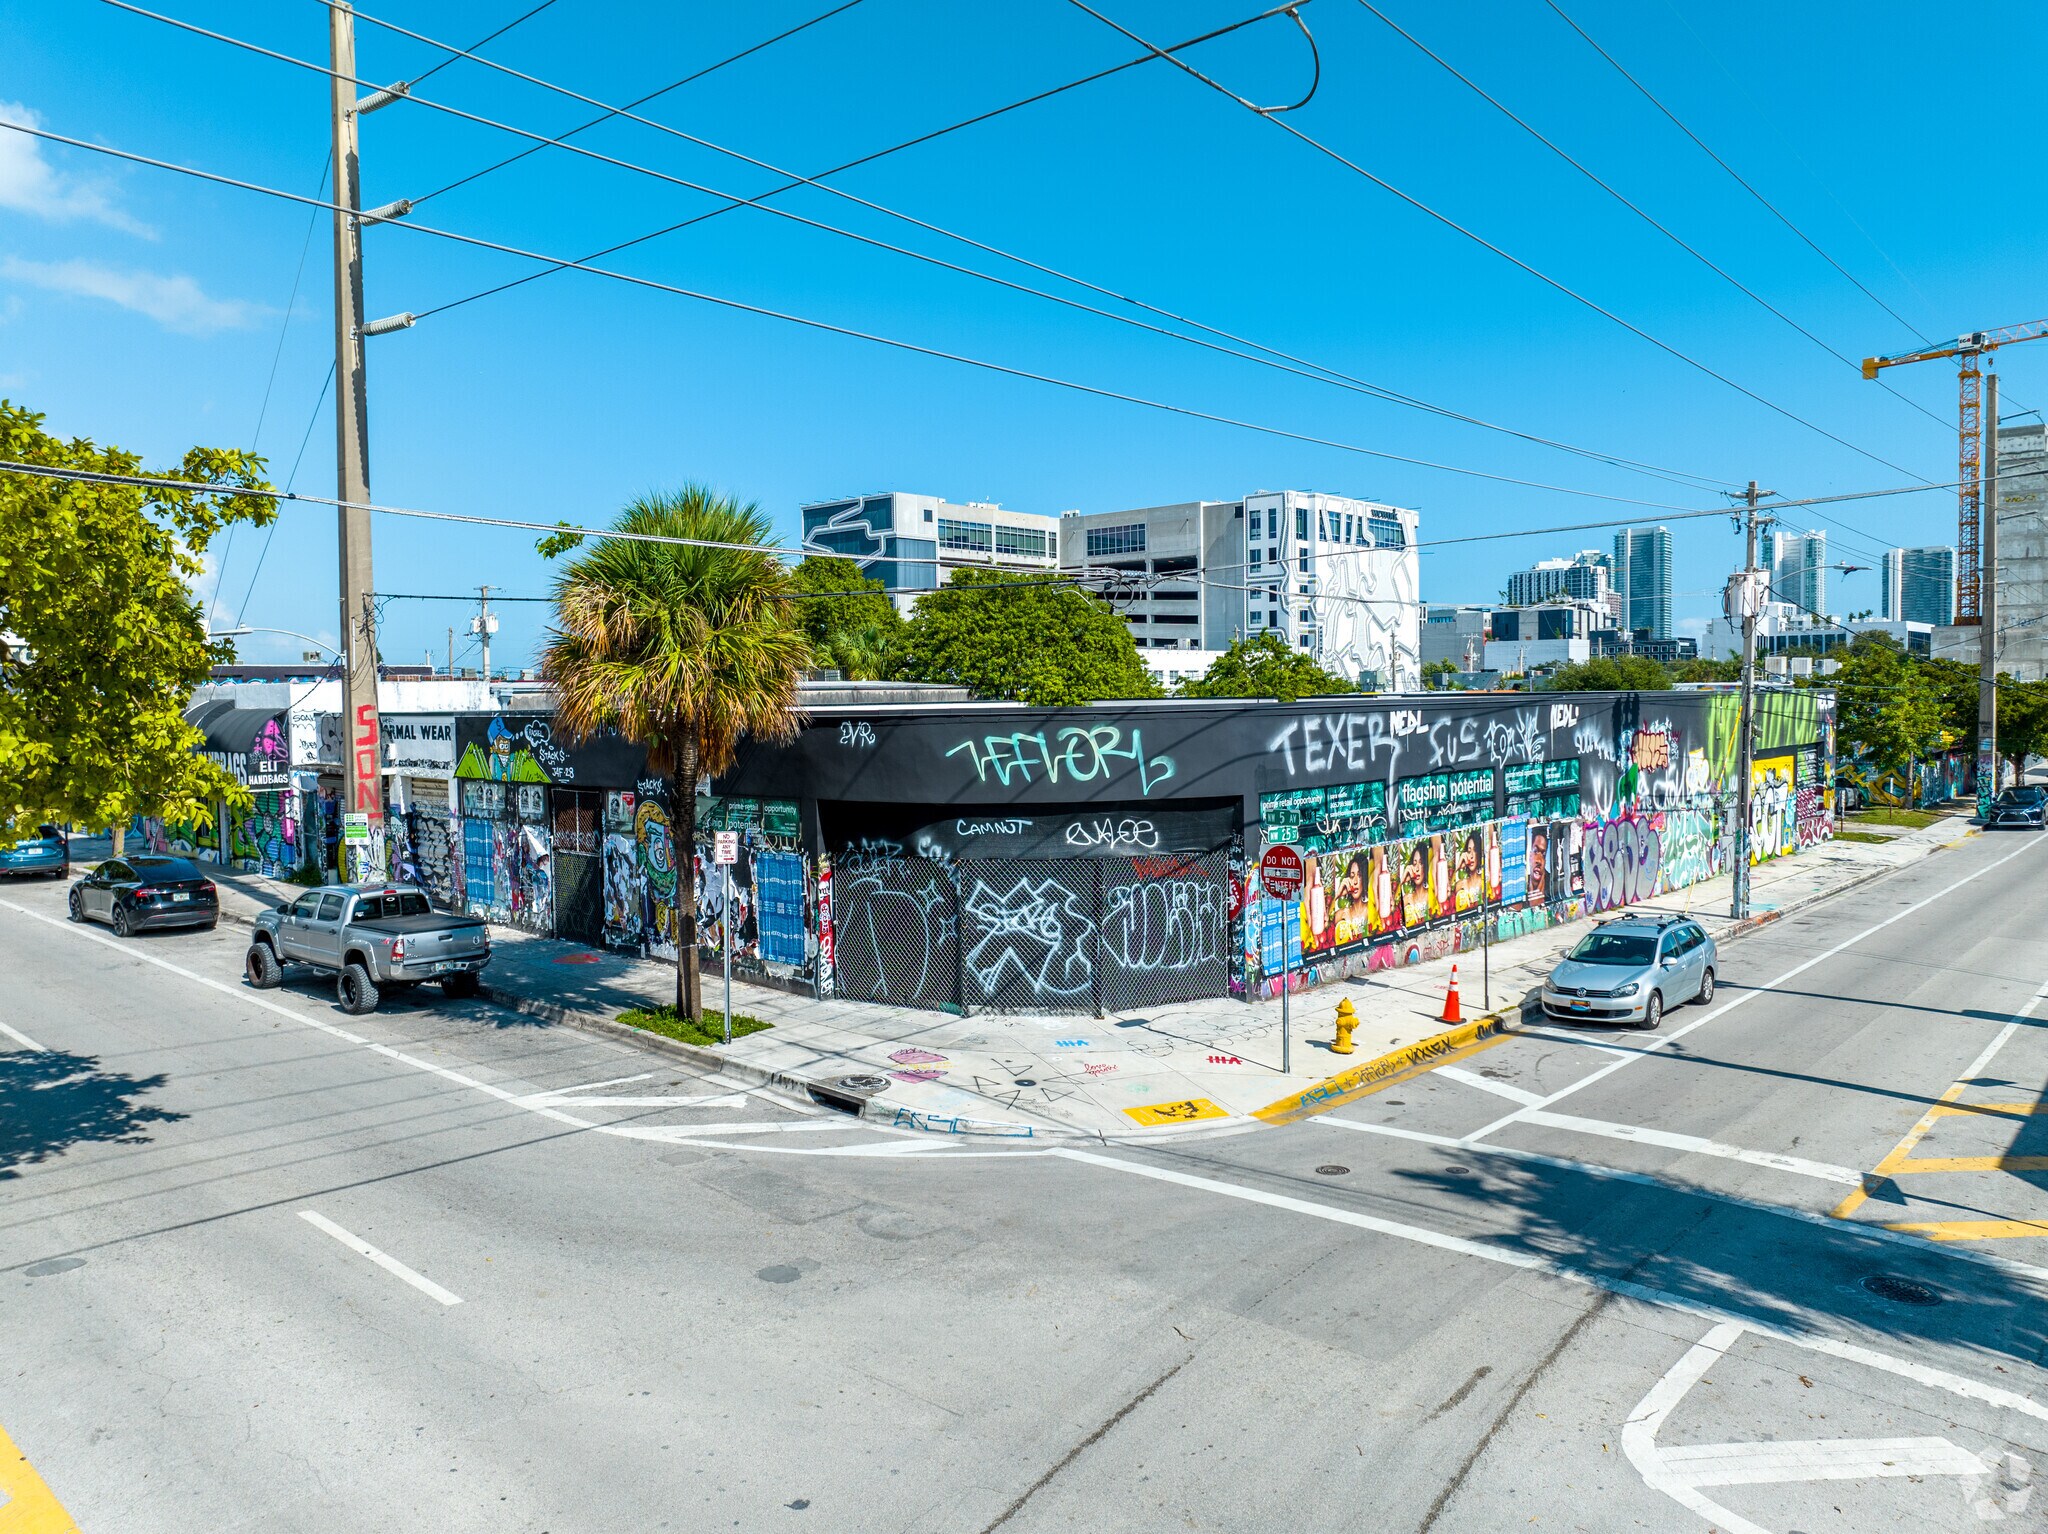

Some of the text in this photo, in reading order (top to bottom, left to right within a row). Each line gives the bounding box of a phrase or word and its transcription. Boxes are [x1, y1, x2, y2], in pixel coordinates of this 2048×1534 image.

[421, 725, 452, 741] WEAR
[260, 761, 278, 772] ELI
[249, 775, 289, 785] HANDBAGS
[1402, 780, 1447, 805] flagship
[1451, 776, 1494, 801] potential
[1279, 798, 1292, 806] retail
[1293, 795, 1323, 807] opportunity
[764, 806, 797, 815] opportunity
[1267, 813, 1276, 821] NW
[1280, 812, 1285, 824] 5
[728, 821, 760, 831] potential
[1270, 832, 1279, 840] NW
[1282, 828, 1291, 840] 25
[1266, 856, 1297, 866] DO NOT
